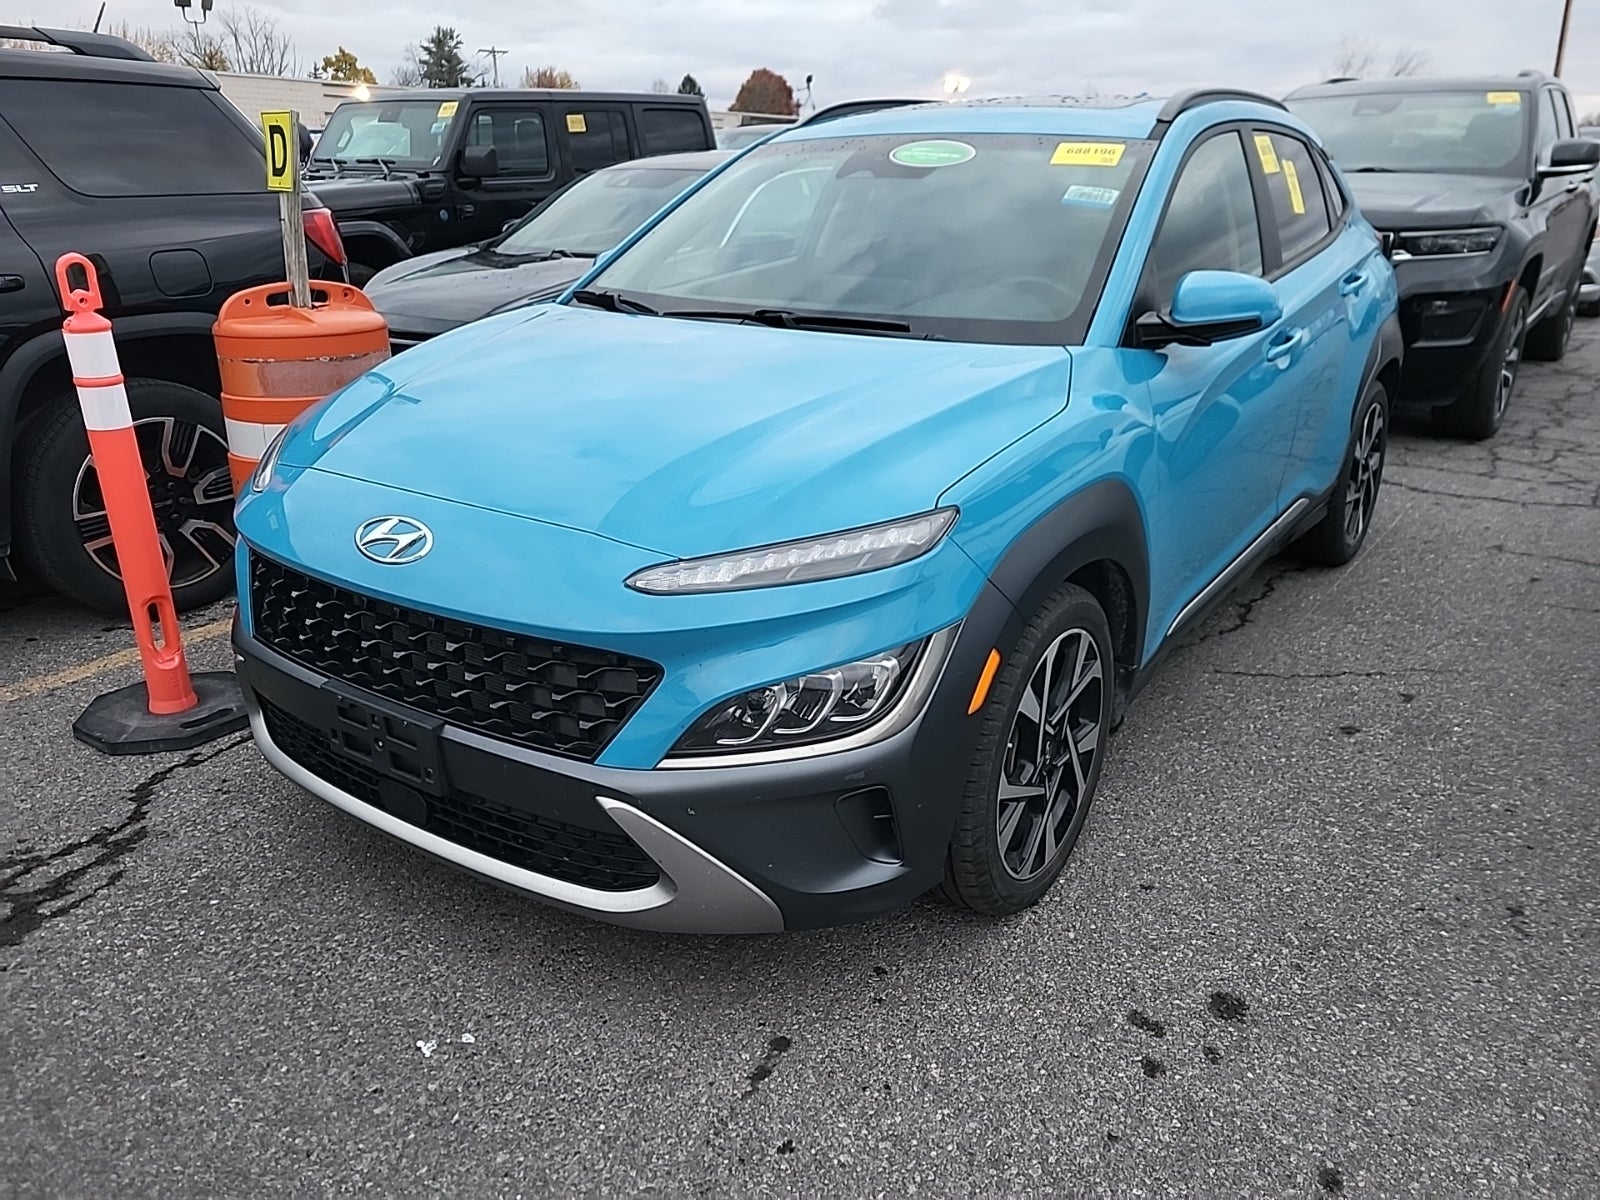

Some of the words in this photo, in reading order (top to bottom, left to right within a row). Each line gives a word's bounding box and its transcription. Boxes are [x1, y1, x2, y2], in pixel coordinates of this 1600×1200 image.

[268, 124, 287, 177] D
[1066, 147, 1117, 156] 688196
[1, 183, 39, 193] SLT
